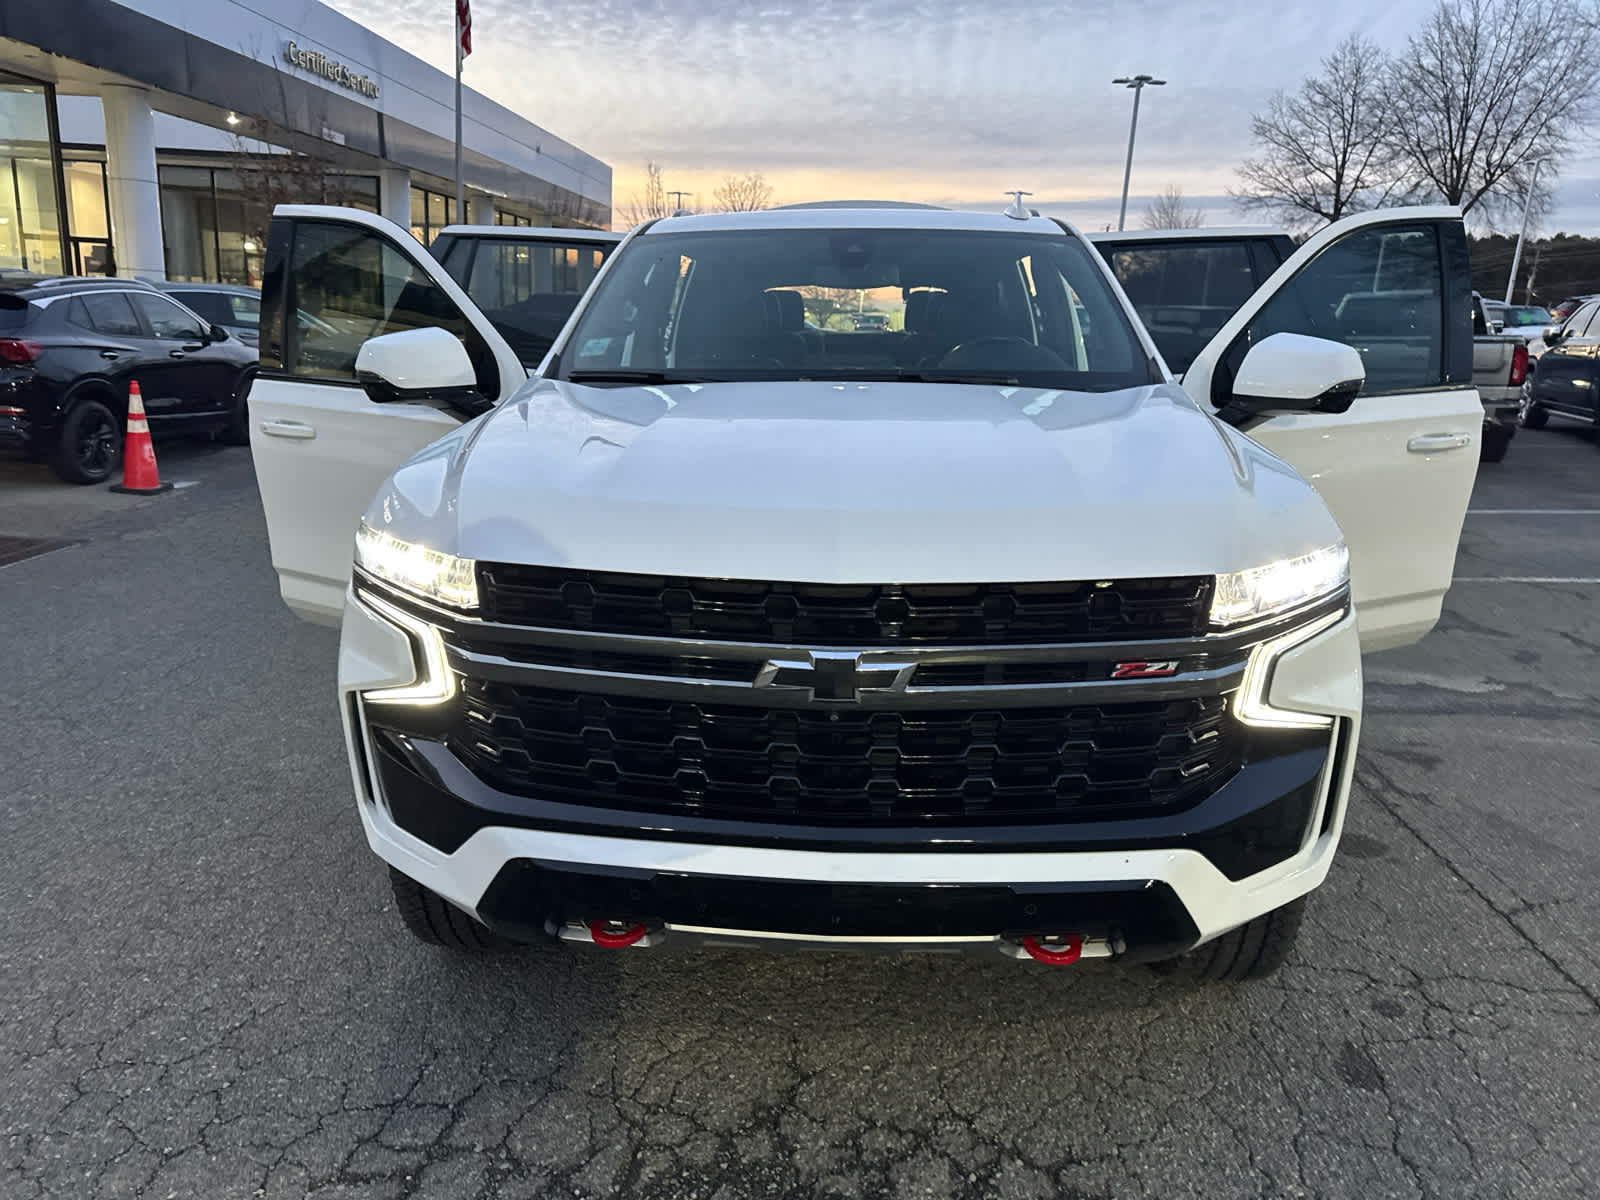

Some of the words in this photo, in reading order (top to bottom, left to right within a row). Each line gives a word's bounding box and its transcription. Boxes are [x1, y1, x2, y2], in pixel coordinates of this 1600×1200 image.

[288, 41, 341, 81] Certified
[340, 65, 380, 98] Service
[1110, 661, 1179, 678] Z71
